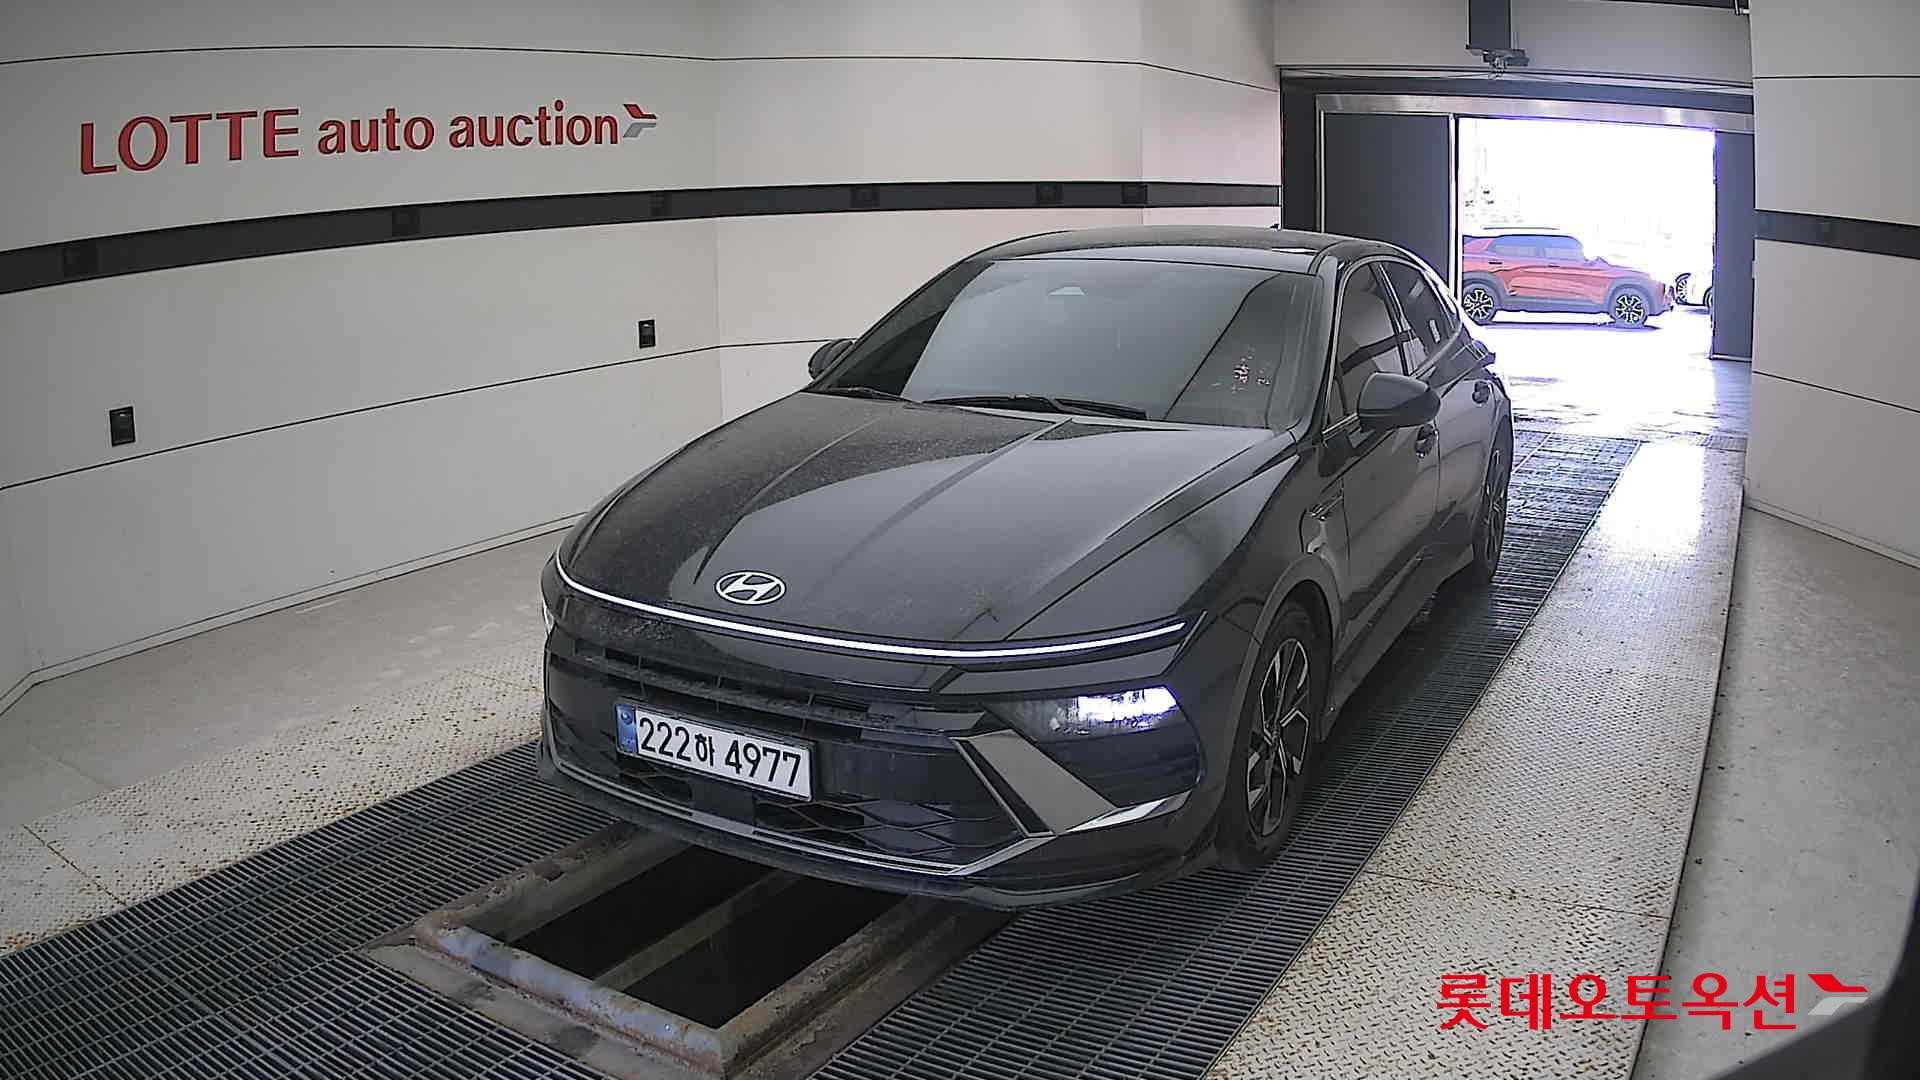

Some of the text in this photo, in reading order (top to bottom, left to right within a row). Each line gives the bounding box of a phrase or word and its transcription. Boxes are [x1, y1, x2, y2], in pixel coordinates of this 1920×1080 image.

[80, 99, 620, 176] LOTTE auto auction
[639, 717, 801, 787] 222하 4977
